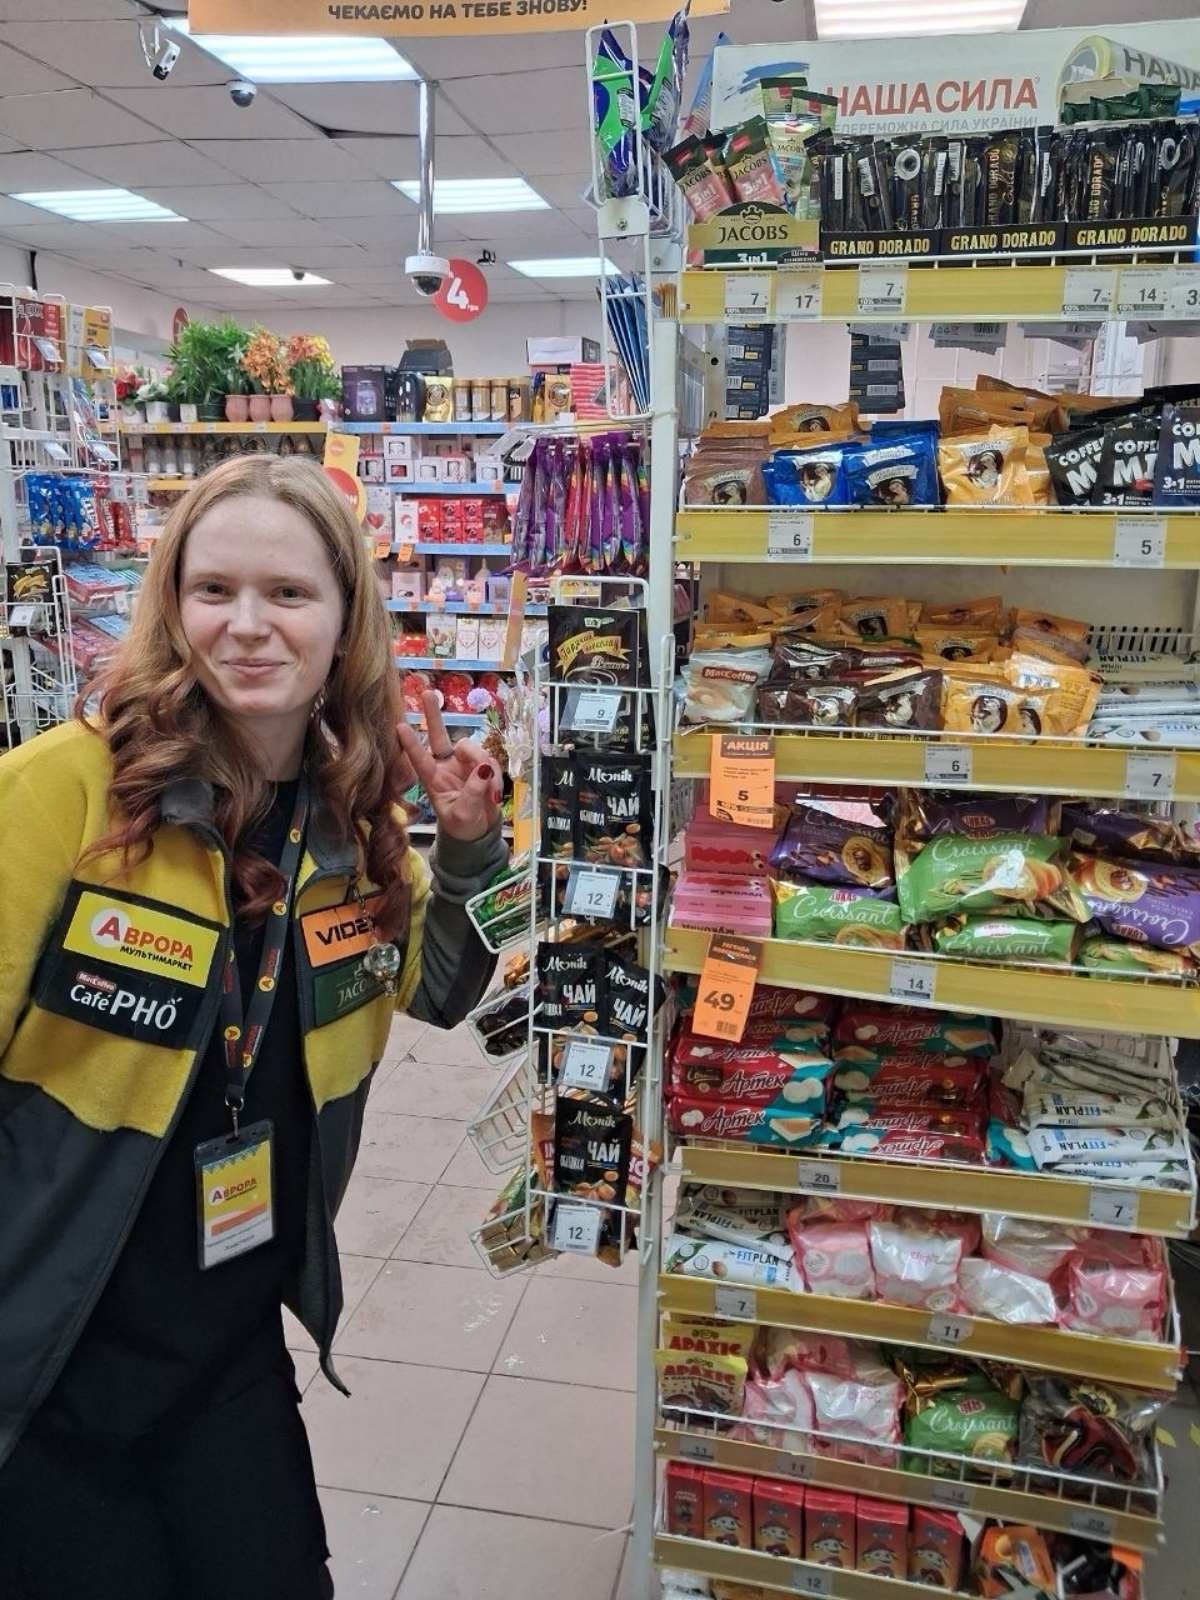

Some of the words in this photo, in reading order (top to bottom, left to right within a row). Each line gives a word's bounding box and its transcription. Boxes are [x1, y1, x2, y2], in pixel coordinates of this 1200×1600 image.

[328, 4, 425, 20] ЧЕКАЄМО
[429, 4, 457, 20] НА
[462, 1, 511, 18] ТЕБЕ
[516, 0, 588, 16] ЗНОВУ!
[935, 78, 1038, 113] СИЛА
[931, 119, 969, 132] СИЛА
[733, 156, 768, 180] JACOBS
[719, 224, 789, 244] JACOBS
[950, 232, 998, 251] GRANO
[1002, 229, 1056, 248] DORADO
[1076, 227, 1126, 246] GRANO
[1131, 224, 1188, 242] DORADO
[830, 239, 875, 255] GRANO
[878, 238, 931, 255] DORADO
[447, 277, 469, 310] 4
[886, 283, 895, 297] 7
[1092, 288, 1102, 303] 7
[1138, 287, 1157, 302] 14
[751, 293, 759, 306] 7
[795, 295, 814, 309] 17
[793, 534, 801, 547] 6
[1141, 539, 1152, 555] 5
[726, 741, 769, 752] АКЦІЯ
[951, 760, 960, 773] 6
[1152, 773, 1162, 788] 7
[738, 790, 749, 801] 5
[606, 794, 640, 817] ЧАЙ
[931, 835, 1036, 864] Croissant
[587, 893, 604, 906] 12
[97, 915, 193, 962] АВРОРА
[119, 944, 193, 972] МУЛЬТИМАРКЕТ
[563, 979, 596, 1003] ЧАЙ
[908, 977, 924, 990] 14
[70, 984, 113, 1011] Café
[703, 993, 736, 1012] 49
[613, 998, 647, 1027] ЧАЙ
[579, 1063, 595, 1077] 12
[719, 1069, 787, 1098] Артек
[702, 1106, 767, 1135] Артек
[587, 1138, 621, 1163] ЧАЙ
[814, 1173, 830, 1184] 20
[1114, 1205, 1124, 1219] 7
[568, 1226, 583, 1240] 12
[735, 1250, 779, 1266] FITPLAN
[737, 1301, 747, 1312] 7
[943, 1324, 960, 1339] 11
[929, 1408, 1017, 1441] Croissant
[806, 1575, 822, 1588] 12
